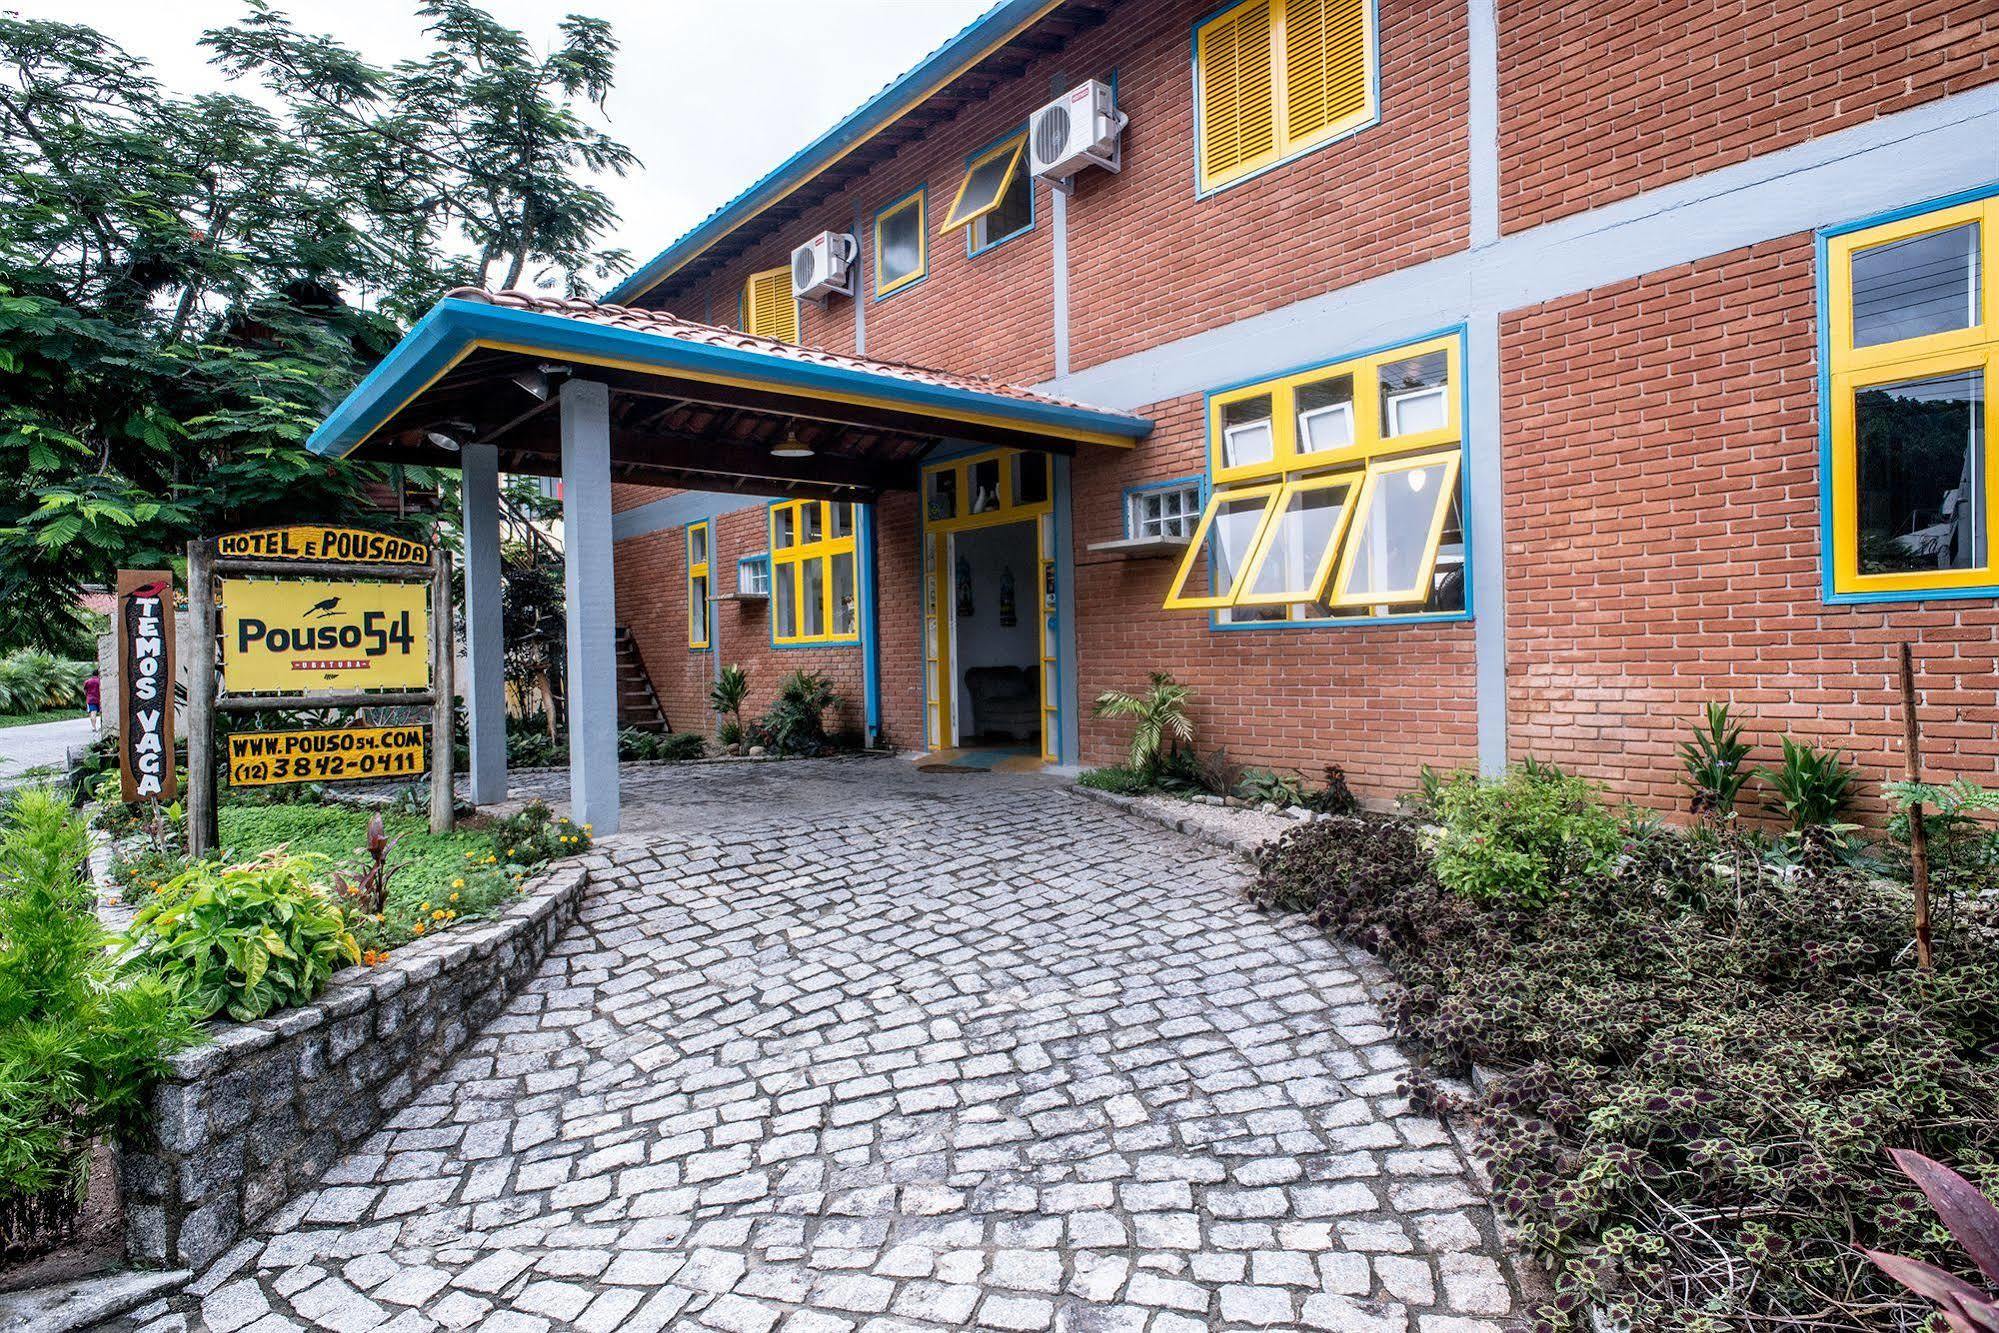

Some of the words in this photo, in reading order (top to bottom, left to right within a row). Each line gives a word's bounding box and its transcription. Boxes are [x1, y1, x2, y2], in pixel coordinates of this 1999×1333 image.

[222, 531, 299, 554] HOTEL
[305, 541, 317, 556] E
[321, 530, 424, 561] POUSADA
[135, 597, 162, 700] TEMOS
[135, 708, 162, 797] VAGA
[232, 731, 422, 757] WWW.POUSO54.COM
[234, 760, 269, 782] (12)
[272, 752, 415, 778] 3842-0411
